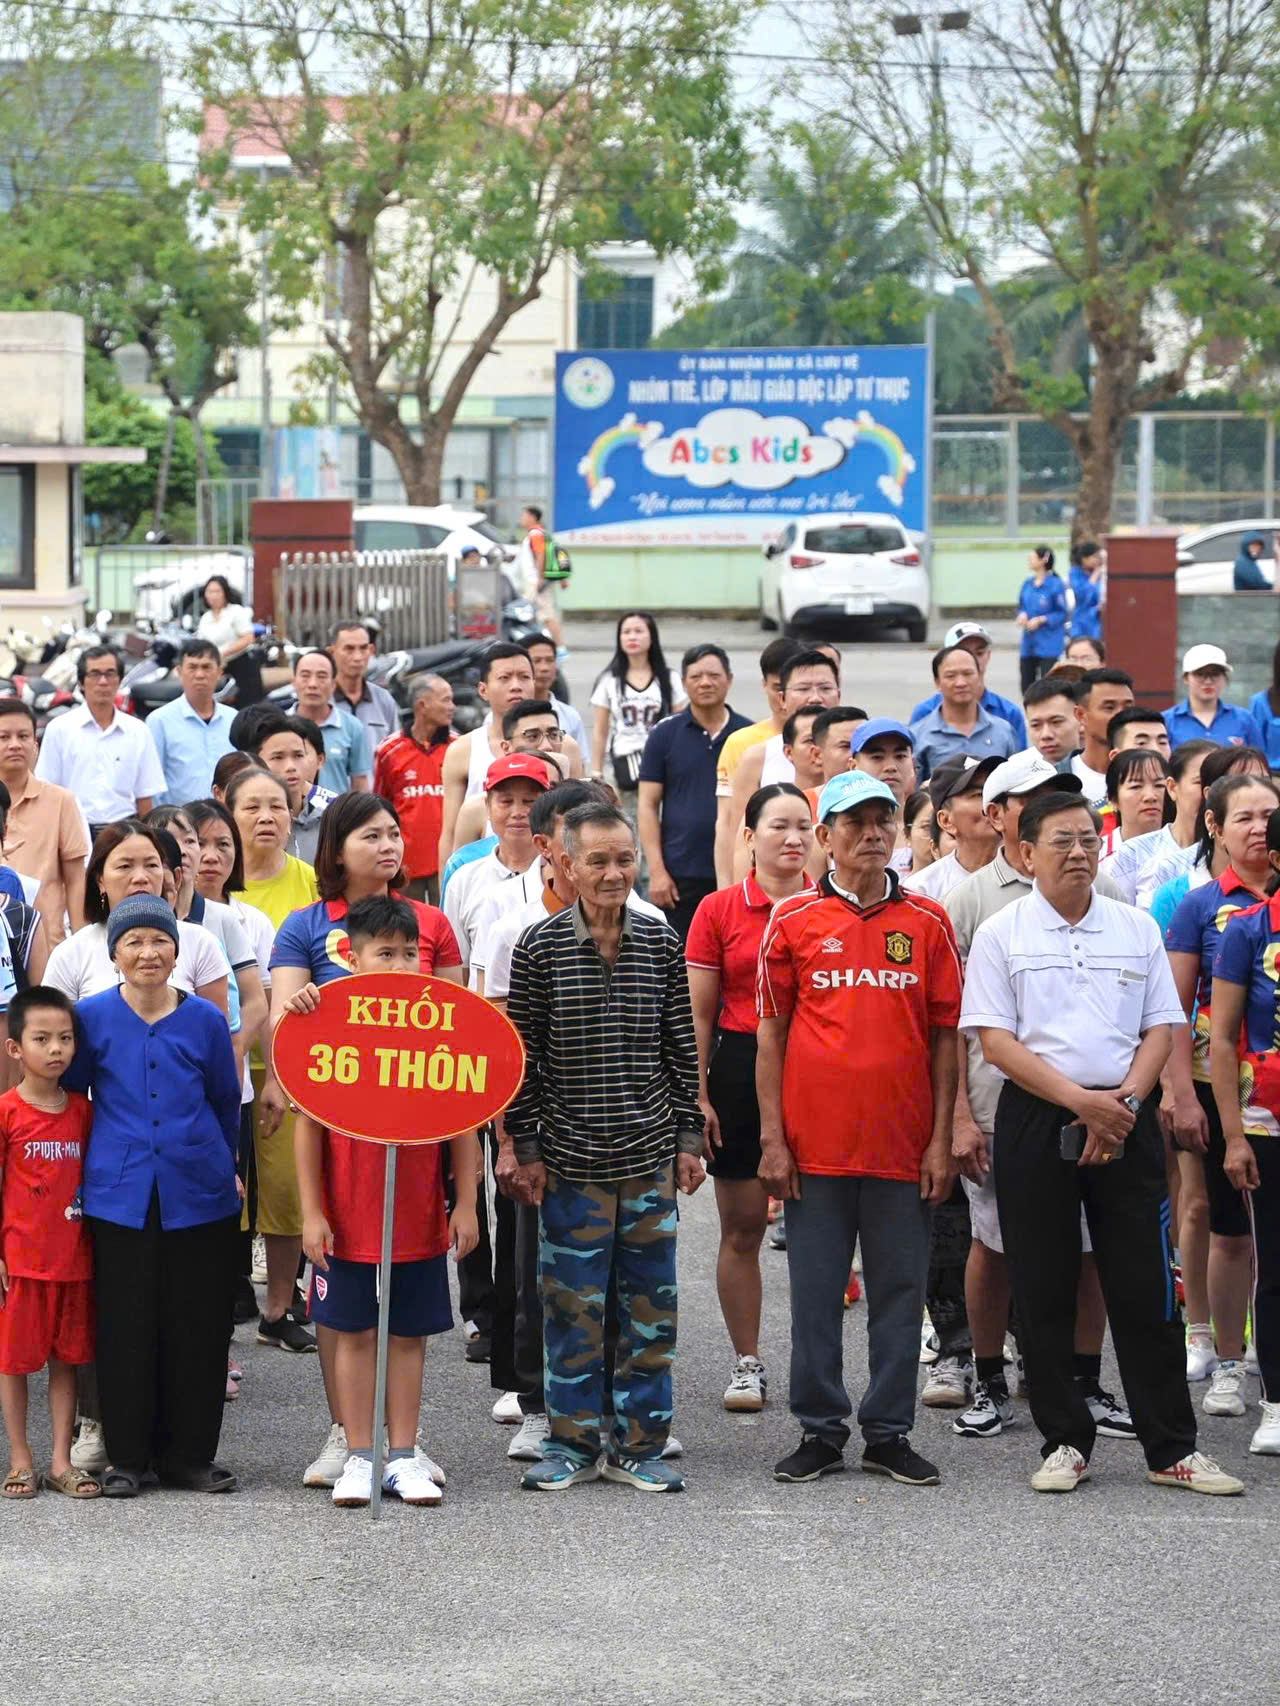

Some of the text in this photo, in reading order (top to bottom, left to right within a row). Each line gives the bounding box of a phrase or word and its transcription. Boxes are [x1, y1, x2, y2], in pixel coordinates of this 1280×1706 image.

[671, 437, 812, 463] Abcs Kids
[402, 784, 445, 798] SHAR
[811, 968, 919, 990] SHARP
[346, 984, 456, 1031] KHỐI
[307, 1043, 488, 1094] 36 THÔN
[23, 1141, 81, 1161] SPIDER-MAN
